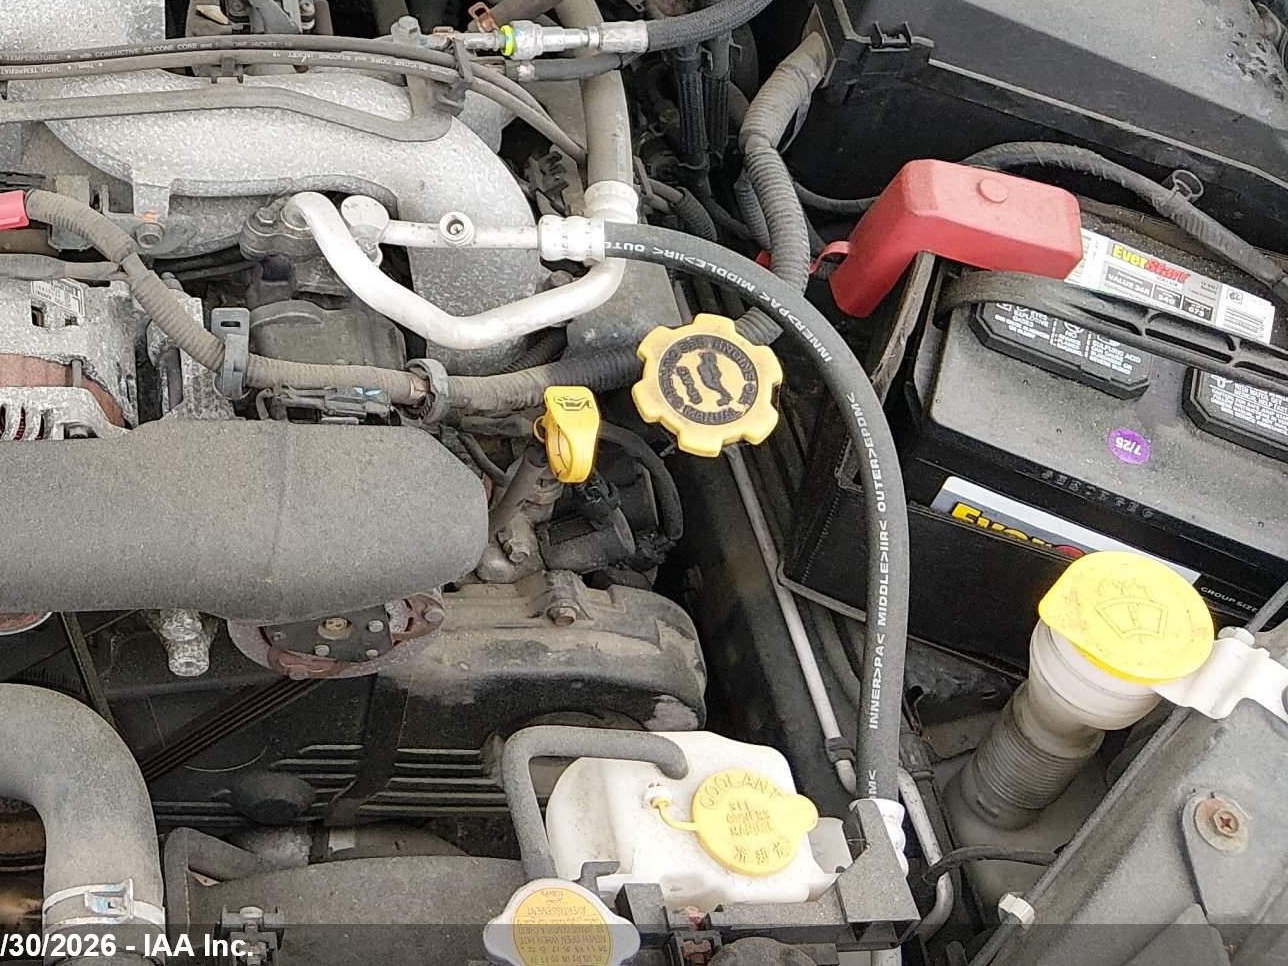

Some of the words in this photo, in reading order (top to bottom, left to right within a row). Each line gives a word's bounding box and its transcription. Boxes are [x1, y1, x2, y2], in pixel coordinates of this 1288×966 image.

[95, 47, 140, 58] CONDUCTIVE
[143, 43, 175, 54] SILICONE
[176, 43, 198, 51] CORE
[318, 53, 352, 61] SILICONE
[1112, 243, 1191, 284] EverStart
[1064, 330, 1078, 339] NO
[1124, 353, 1142, 364] ACID
[844, 392, 888, 514] OUTER>EPDM<
[1115, 436, 1142, 456] 7/25
[1200, 585, 1235, 604] GROUP
[1236, 599, 1259, 614] SIZE
[867, 633, 886, 731] INNER>PA<
[698, 771, 784, 810] COOLANT
